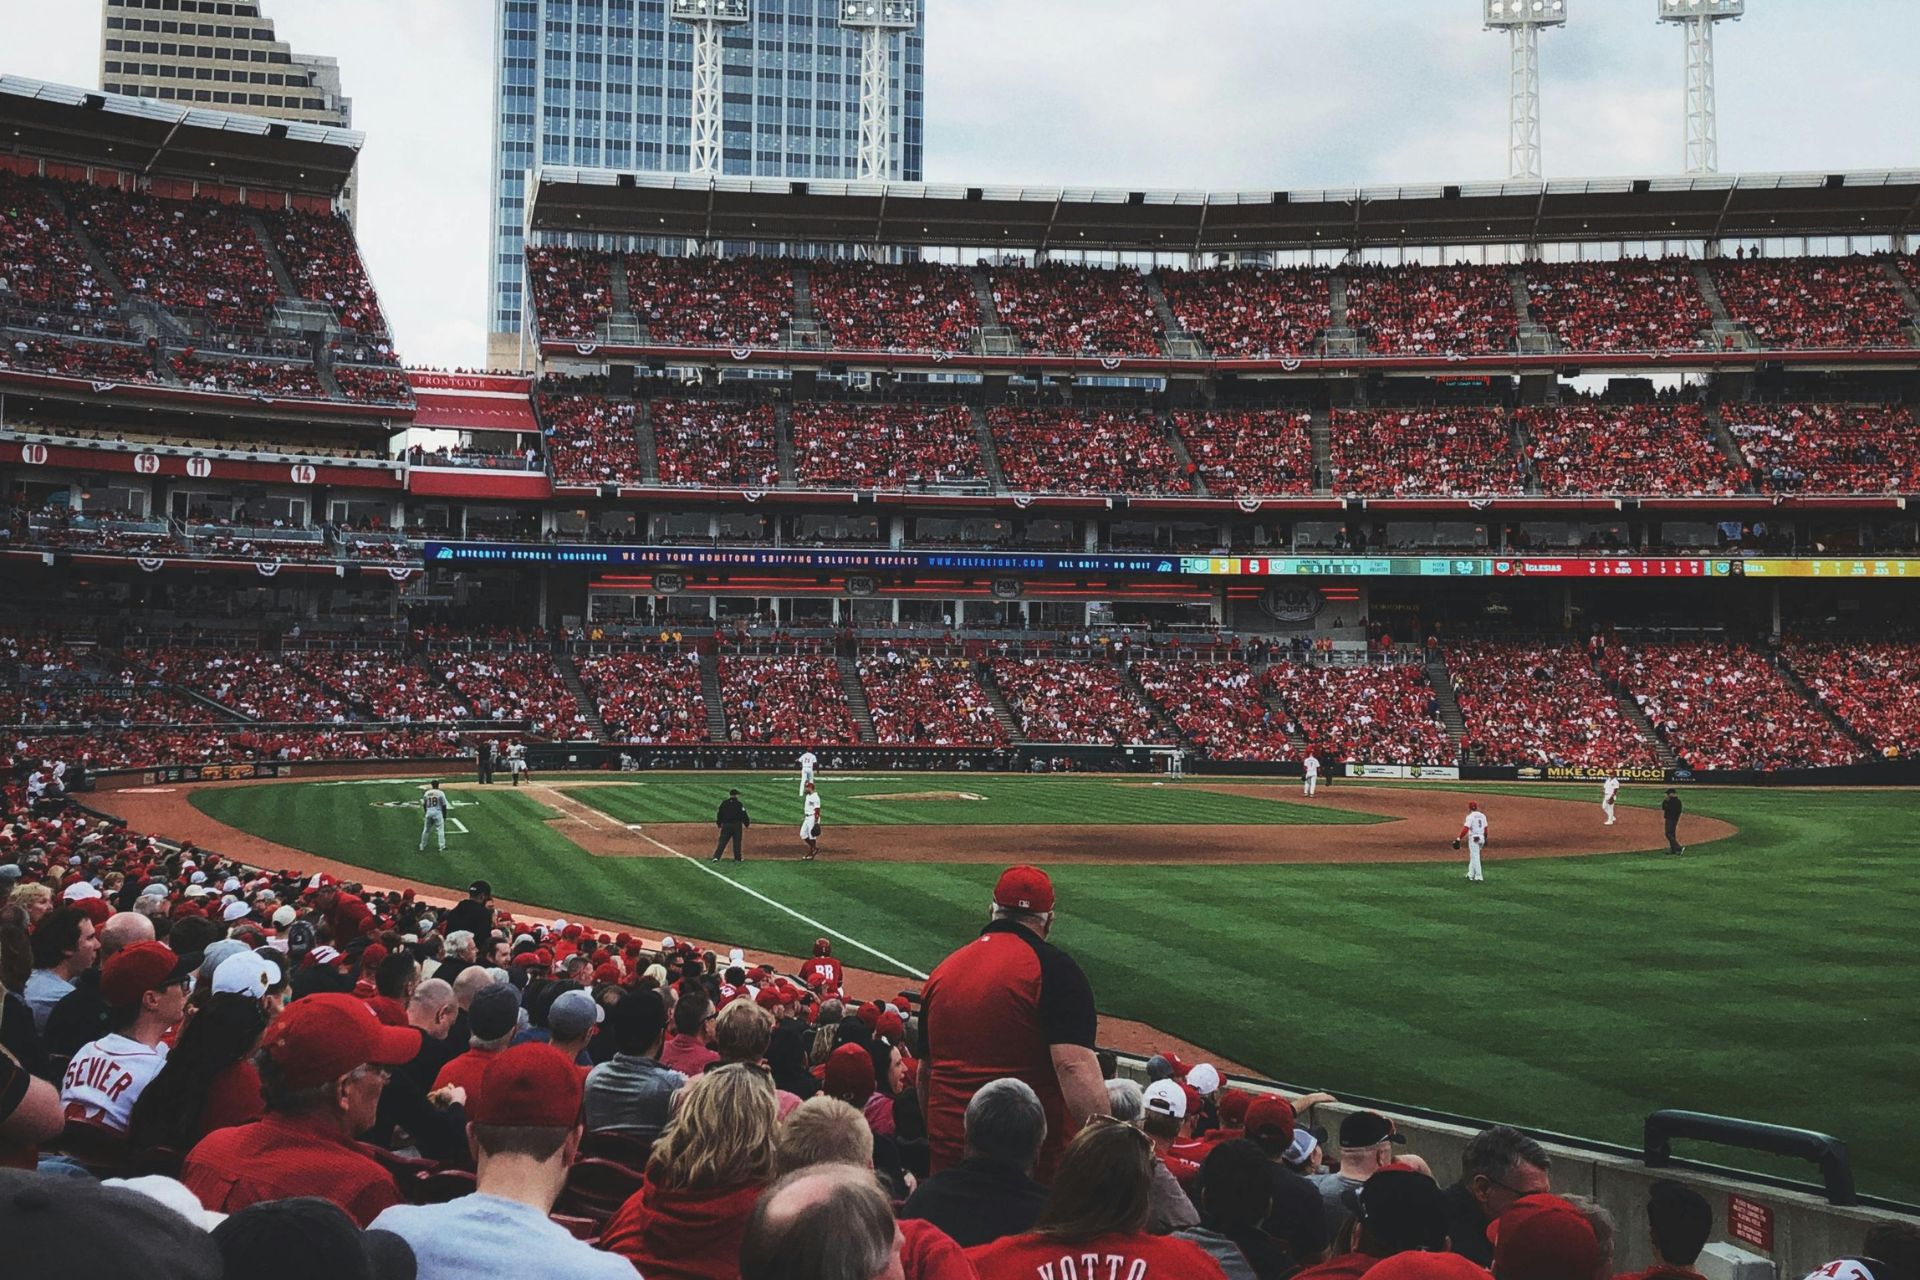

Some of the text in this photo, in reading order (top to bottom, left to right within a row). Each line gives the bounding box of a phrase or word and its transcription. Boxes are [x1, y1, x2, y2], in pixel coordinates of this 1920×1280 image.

[419, 376, 485, 388] FRONTGATE
[27, 444, 44, 463] 10
[139, 454, 155, 473] 13
[191, 458, 206, 477] 11
[295, 465, 312, 483] 14
[456, 550, 608, 561] INTEGRITY EXPRESS LOGISTICS
[622, 552, 919, 566] WE ARE YOUR HOMETOWN SHIPPING SOLUTION EXPERTS
[1058, 560, 1151, 570] ALL GRIT NO QUIT
[1249, 559, 1260, 573] 5
[1350, 565, 1359, 574] 0
[1456, 561, 1474, 572] 94
[1525, 562, 1562, 572] IGLESIAS
[850, 577, 871, 588] FOX
[997, 580, 1018, 590] FOX
[1272, 591, 1310, 607] FOX
[1547, 768, 1583, 777] MIKE
[1586, 768, 1665, 779] CASTRUCCI
[428, 796, 438, 807] 18
[65, 1056, 133, 1103] SEVIER
[1037, 1253, 1147, 1280] VOTTO
